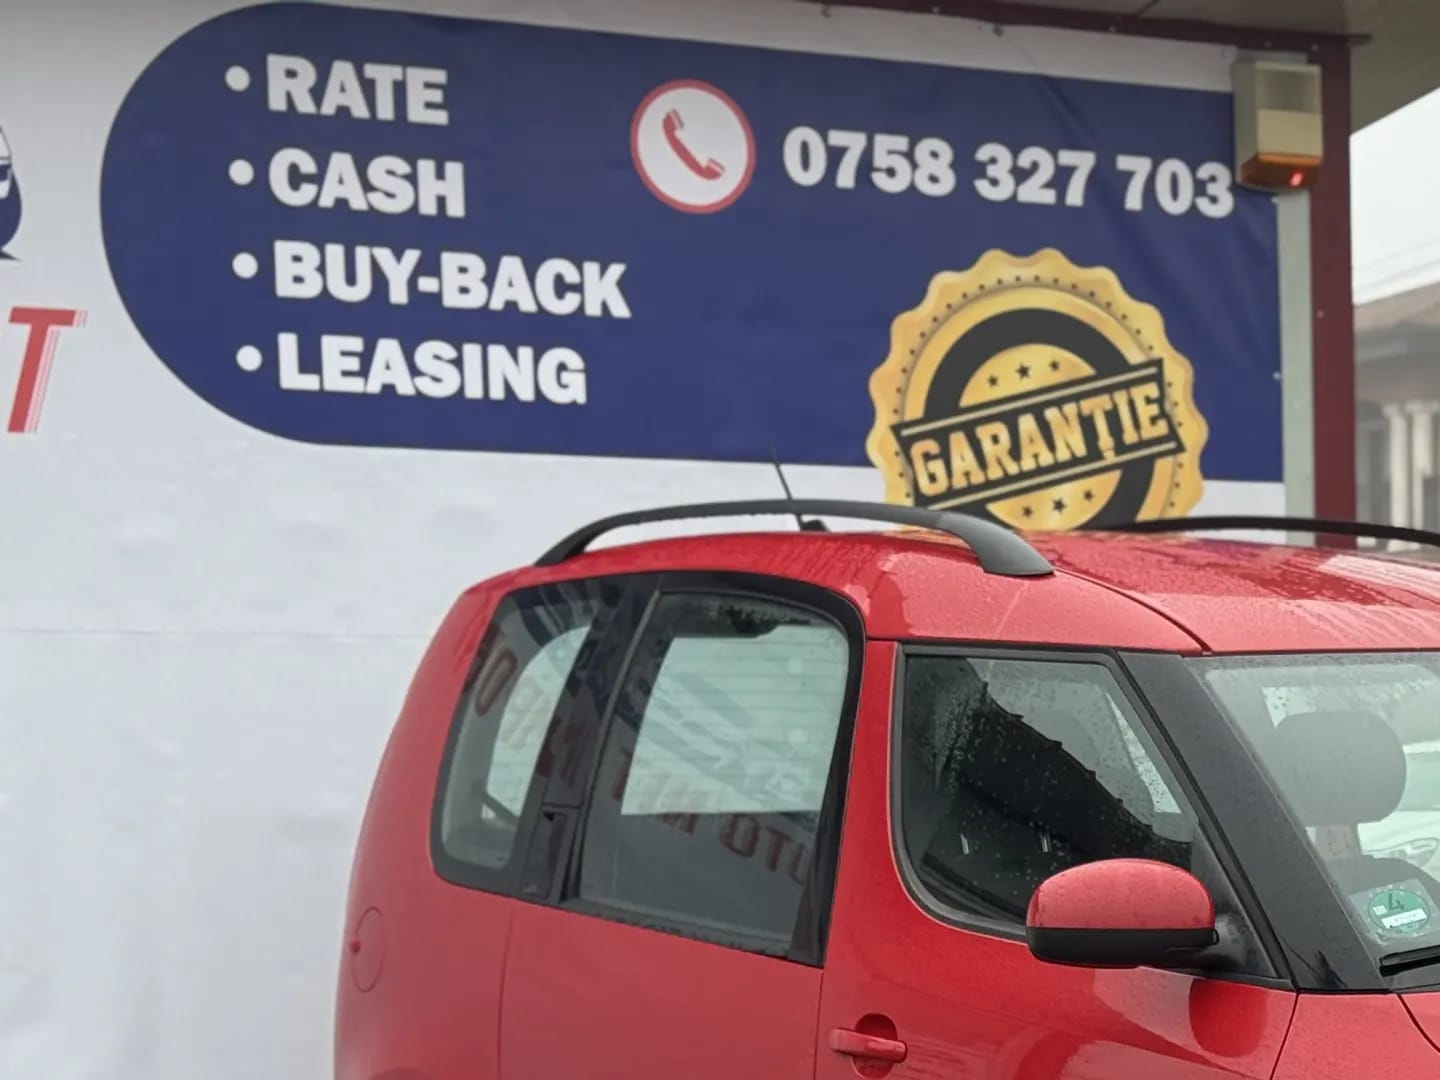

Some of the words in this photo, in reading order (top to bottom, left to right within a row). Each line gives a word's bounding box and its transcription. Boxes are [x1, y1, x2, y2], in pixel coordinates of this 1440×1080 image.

[266, 53, 449, 126] RATE
[268, 147, 466, 219] CASH
[782, 125, 956, 197] 0758
[973, 142, 1096, 208] 327
[1115, 155, 1236, 219] 703
[273, 239, 632, 319] BUY-BACK
[277, 332, 588, 405] LEASING
